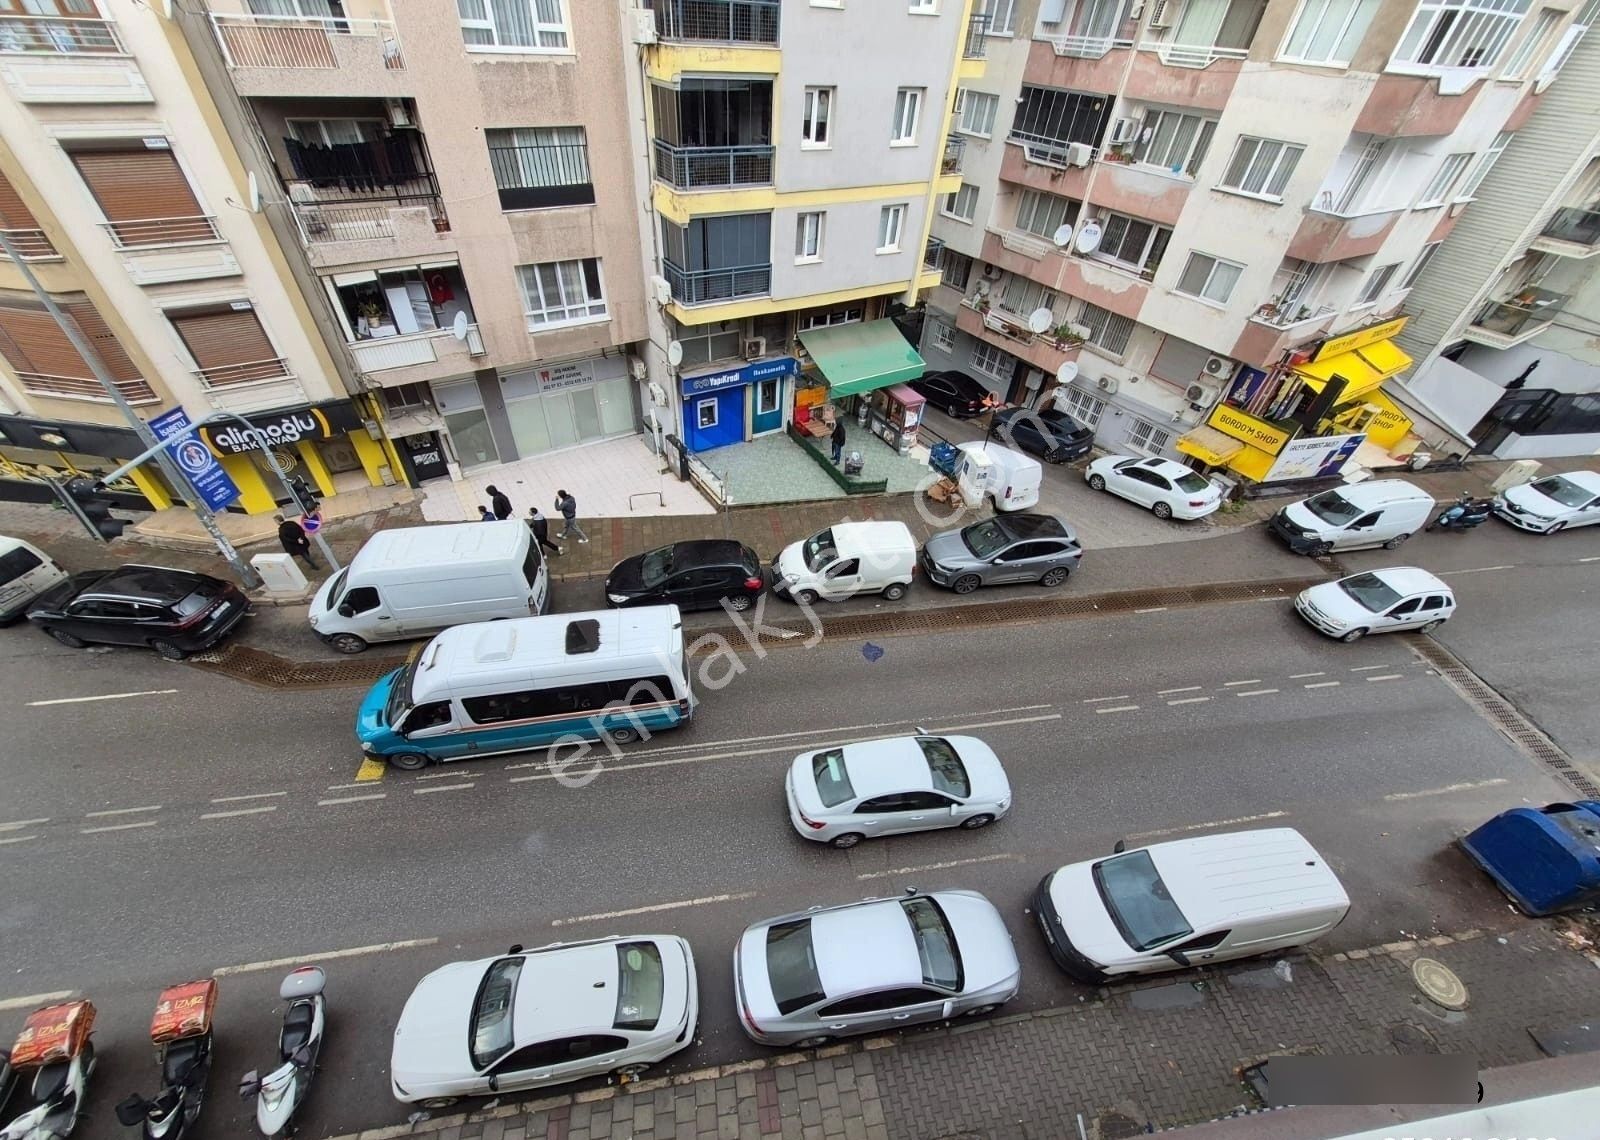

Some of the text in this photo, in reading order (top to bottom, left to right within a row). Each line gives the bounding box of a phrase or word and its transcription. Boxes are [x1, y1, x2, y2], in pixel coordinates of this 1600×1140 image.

[1219, 414, 1255, 436] BORDO'M
[1254, 430, 1279, 446] SHOP
[1372, 418, 1394, 430] SHOP
[231, 434, 290, 453] BAKAVA
